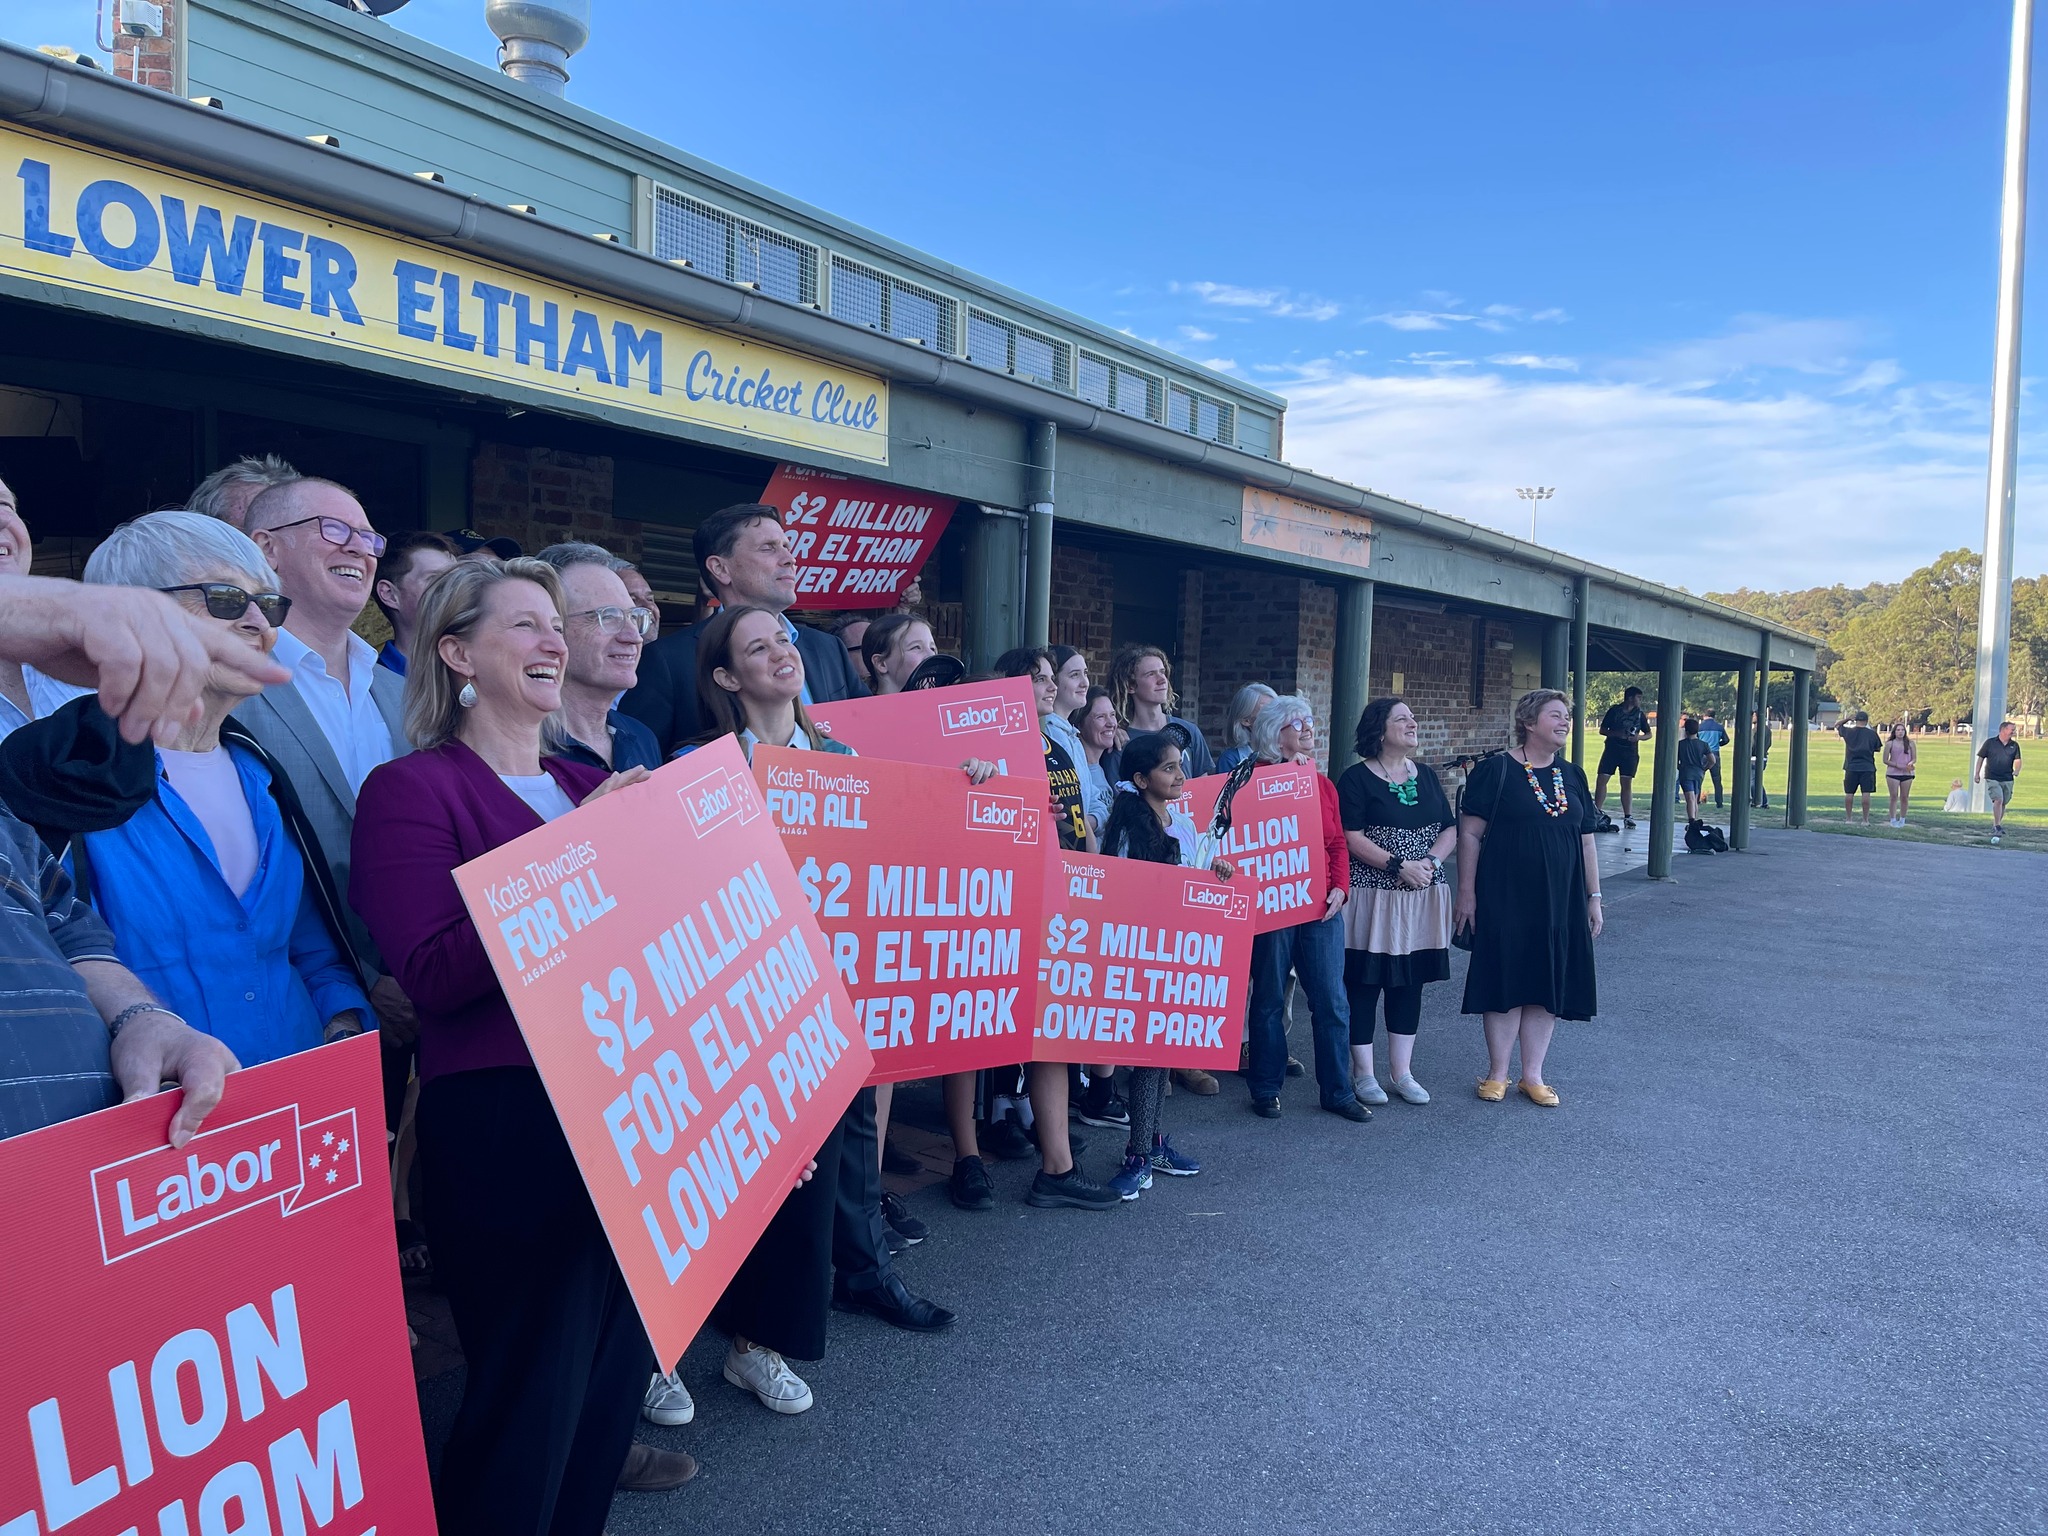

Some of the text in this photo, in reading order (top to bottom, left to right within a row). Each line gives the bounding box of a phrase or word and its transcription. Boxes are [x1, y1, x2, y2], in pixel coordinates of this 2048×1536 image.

[17, 158, 878, 430] LOWER ELTHAM Cricket Club
[785, 491, 933, 533] $2 MILLION
[784, 530, 923, 564] OR ELTHAM
[838, 567, 907, 593] PARK
[946, 706, 999, 729] Labor
[767, 765, 870, 795] Kate Thwaites
[1047, 768, 1079, 787] ELTHA
[1052, 785, 1080, 798] LACROS
[1261, 778, 1295, 796] Labor
[687, 779, 732, 826] Labor
[766, 788, 868, 829] FOR ALL
[972, 800, 1018, 826] Labor
[1071, 804, 1086, 838] 6
[1198, 814, 1299, 857] ILLION
[484, 840, 597, 917] Kate Thwaites
[1062, 861, 1106, 878] hwaites
[1238, 846, 1310, 882] THAM
[798, 856, 1013, 917] $2 MILLION
[1069, 876, 1103, 900] ALL
[1188, 886, 1229, 907] Labor
[498, 868, 617, 971] FOR ALL
[1046, 913, 1223, 967] $2 MILLION
[521, 949, 567, 986] JAGAJAGA
[581, 861, 781, 1077] $2 MILLION
[874, 927, 1021, 983] ELTHAM
[1104, 965, 1229, 1008] ELTHAM
[927, 987, 1019, 1043] PARK
[1145, 1010, 1226, 1048] PARK
[603, 1049, 702, 1187] FOR
[689, 924, 819, 1093] ELTHAM
[642, 1084, 781, 1286] LOWER
[767, 992, 849, 1123] PARK
[116, 1138, 280, 1236] Labor
[0, 1284, 307, 1536] LION
